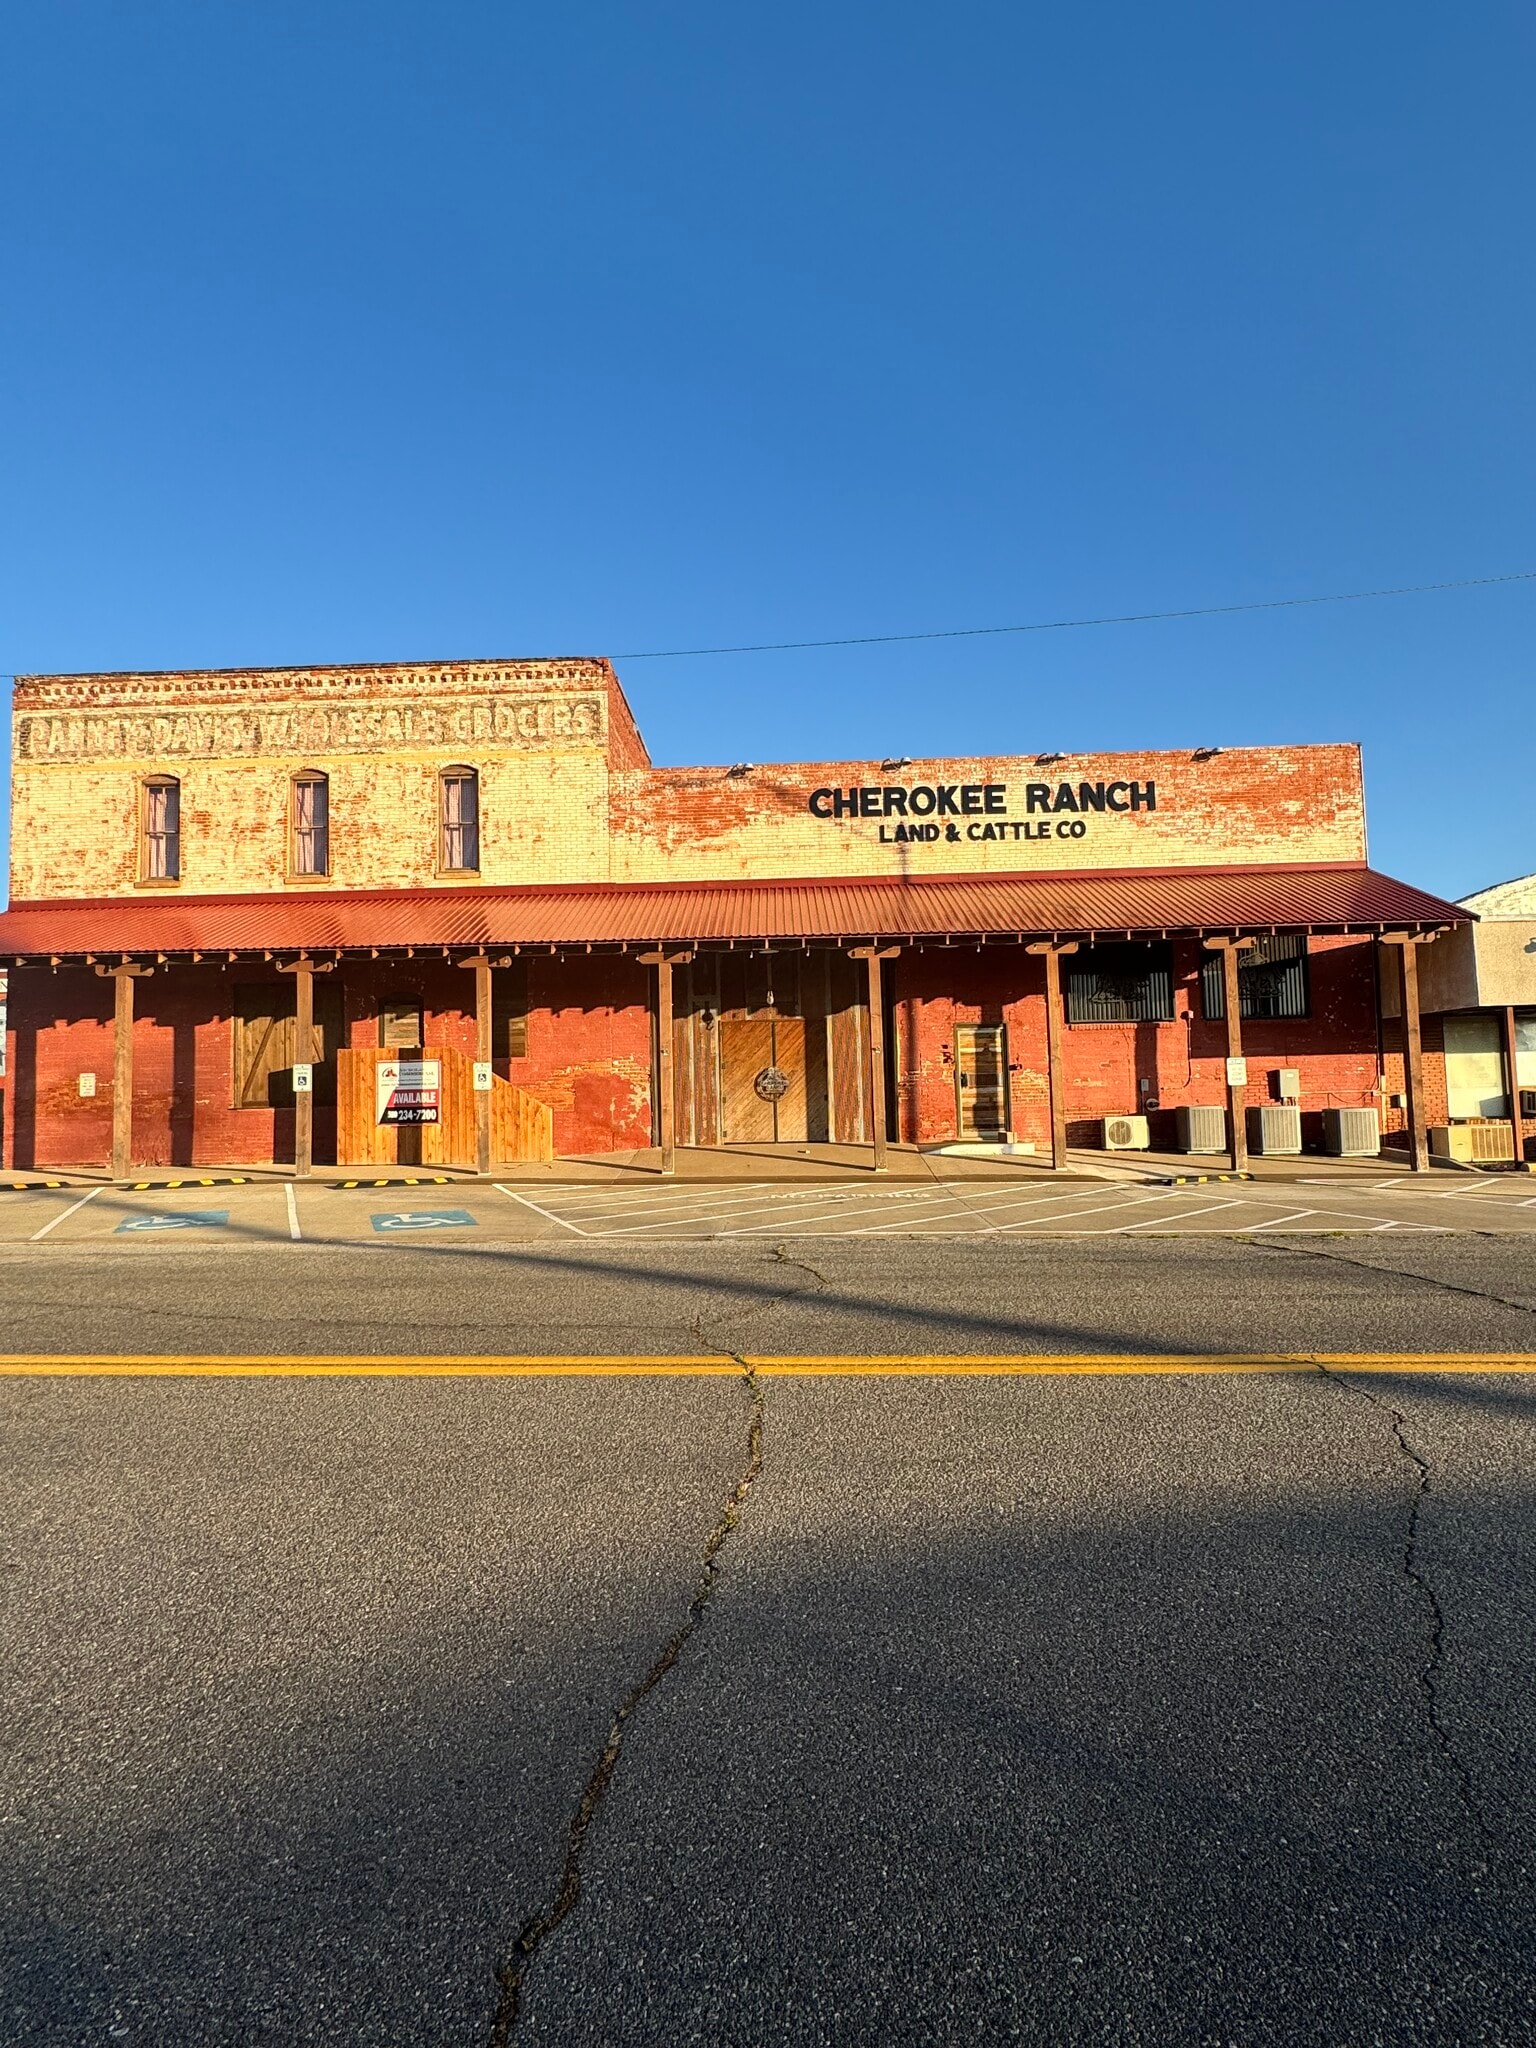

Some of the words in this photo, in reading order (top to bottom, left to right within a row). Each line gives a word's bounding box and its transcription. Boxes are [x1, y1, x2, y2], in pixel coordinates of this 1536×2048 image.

[454, 703, 592, 740] GROCERS
[809, 784, 1007, 819] CHEROKEE
[1026, 781, 1156, 814] RANCH
[879, 823, 940, 843] LAND
[945, 822, 961, 843] &
[967, 821, 1051, 841] CATTLE
[1056, 820, 1087, 839] CO
[394, 1091, 436, 1104] AVAILABLE
[398, 1109, 437, 1120] 234-7200
